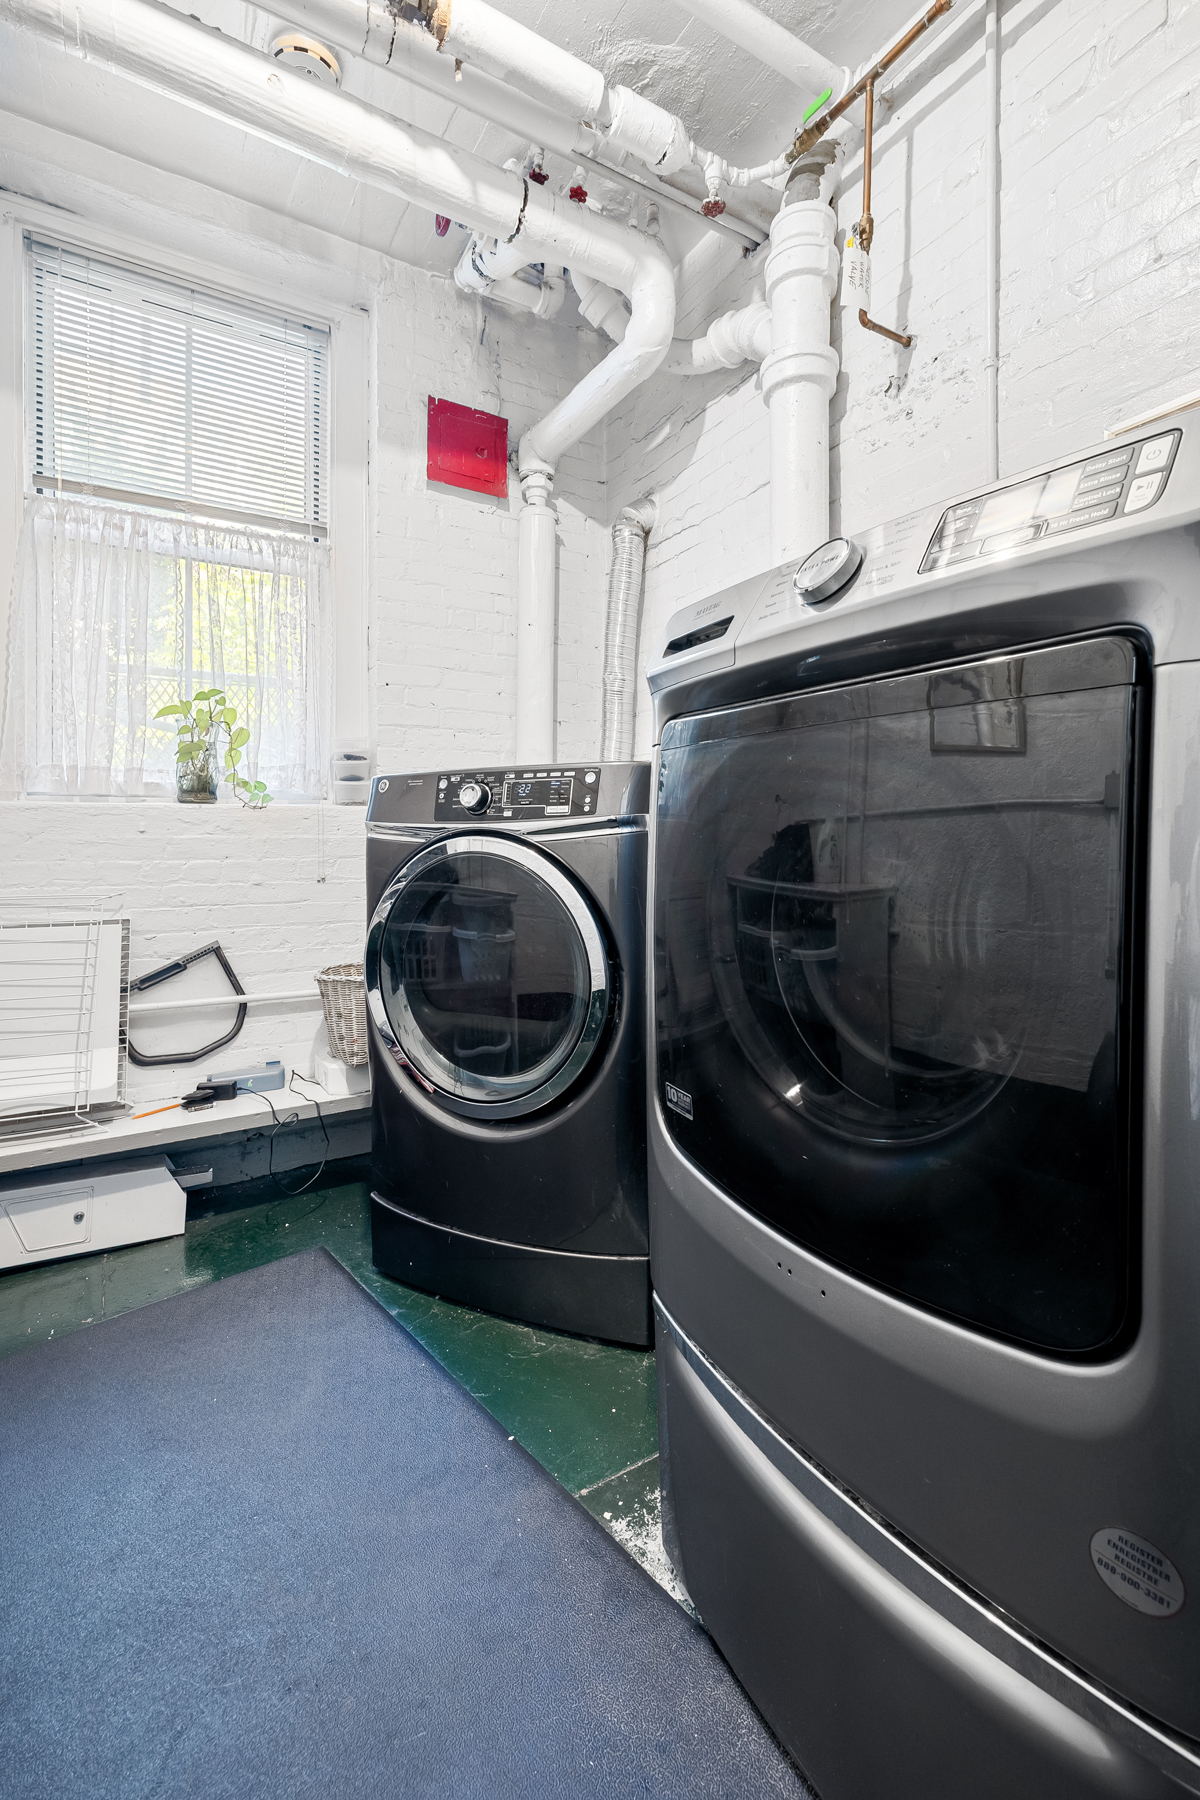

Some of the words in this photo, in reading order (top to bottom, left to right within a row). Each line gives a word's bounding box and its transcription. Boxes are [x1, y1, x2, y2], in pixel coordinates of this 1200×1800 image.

[848, 260, 858, 290] VALVE
[1086, 462, 1107, 472] Delay
[1107, 454, 1128, 465] Start
[1079, 479, 1099, 489] Extra
[1099, 472, 1121, 483] Rinse
[1074, 493, 1102, 505] Control
[1102, 486, 1121, 497] Lock
[1059, 519, 1069, 527] Hr
[1069, 512, 1090, 524] Fresh
[1090, 508, 1110, 519] Hold
[667, 1086, 678, 1103] 10
[1107, 1538, 1171, 1583] ENREGISTRER
[1117, 1535, 1163, 1567] REGISTER
[1114, 1553, 1160, 1587] REGISTRE
[1096, 1557, 1171, 1610] 888-900-3381
